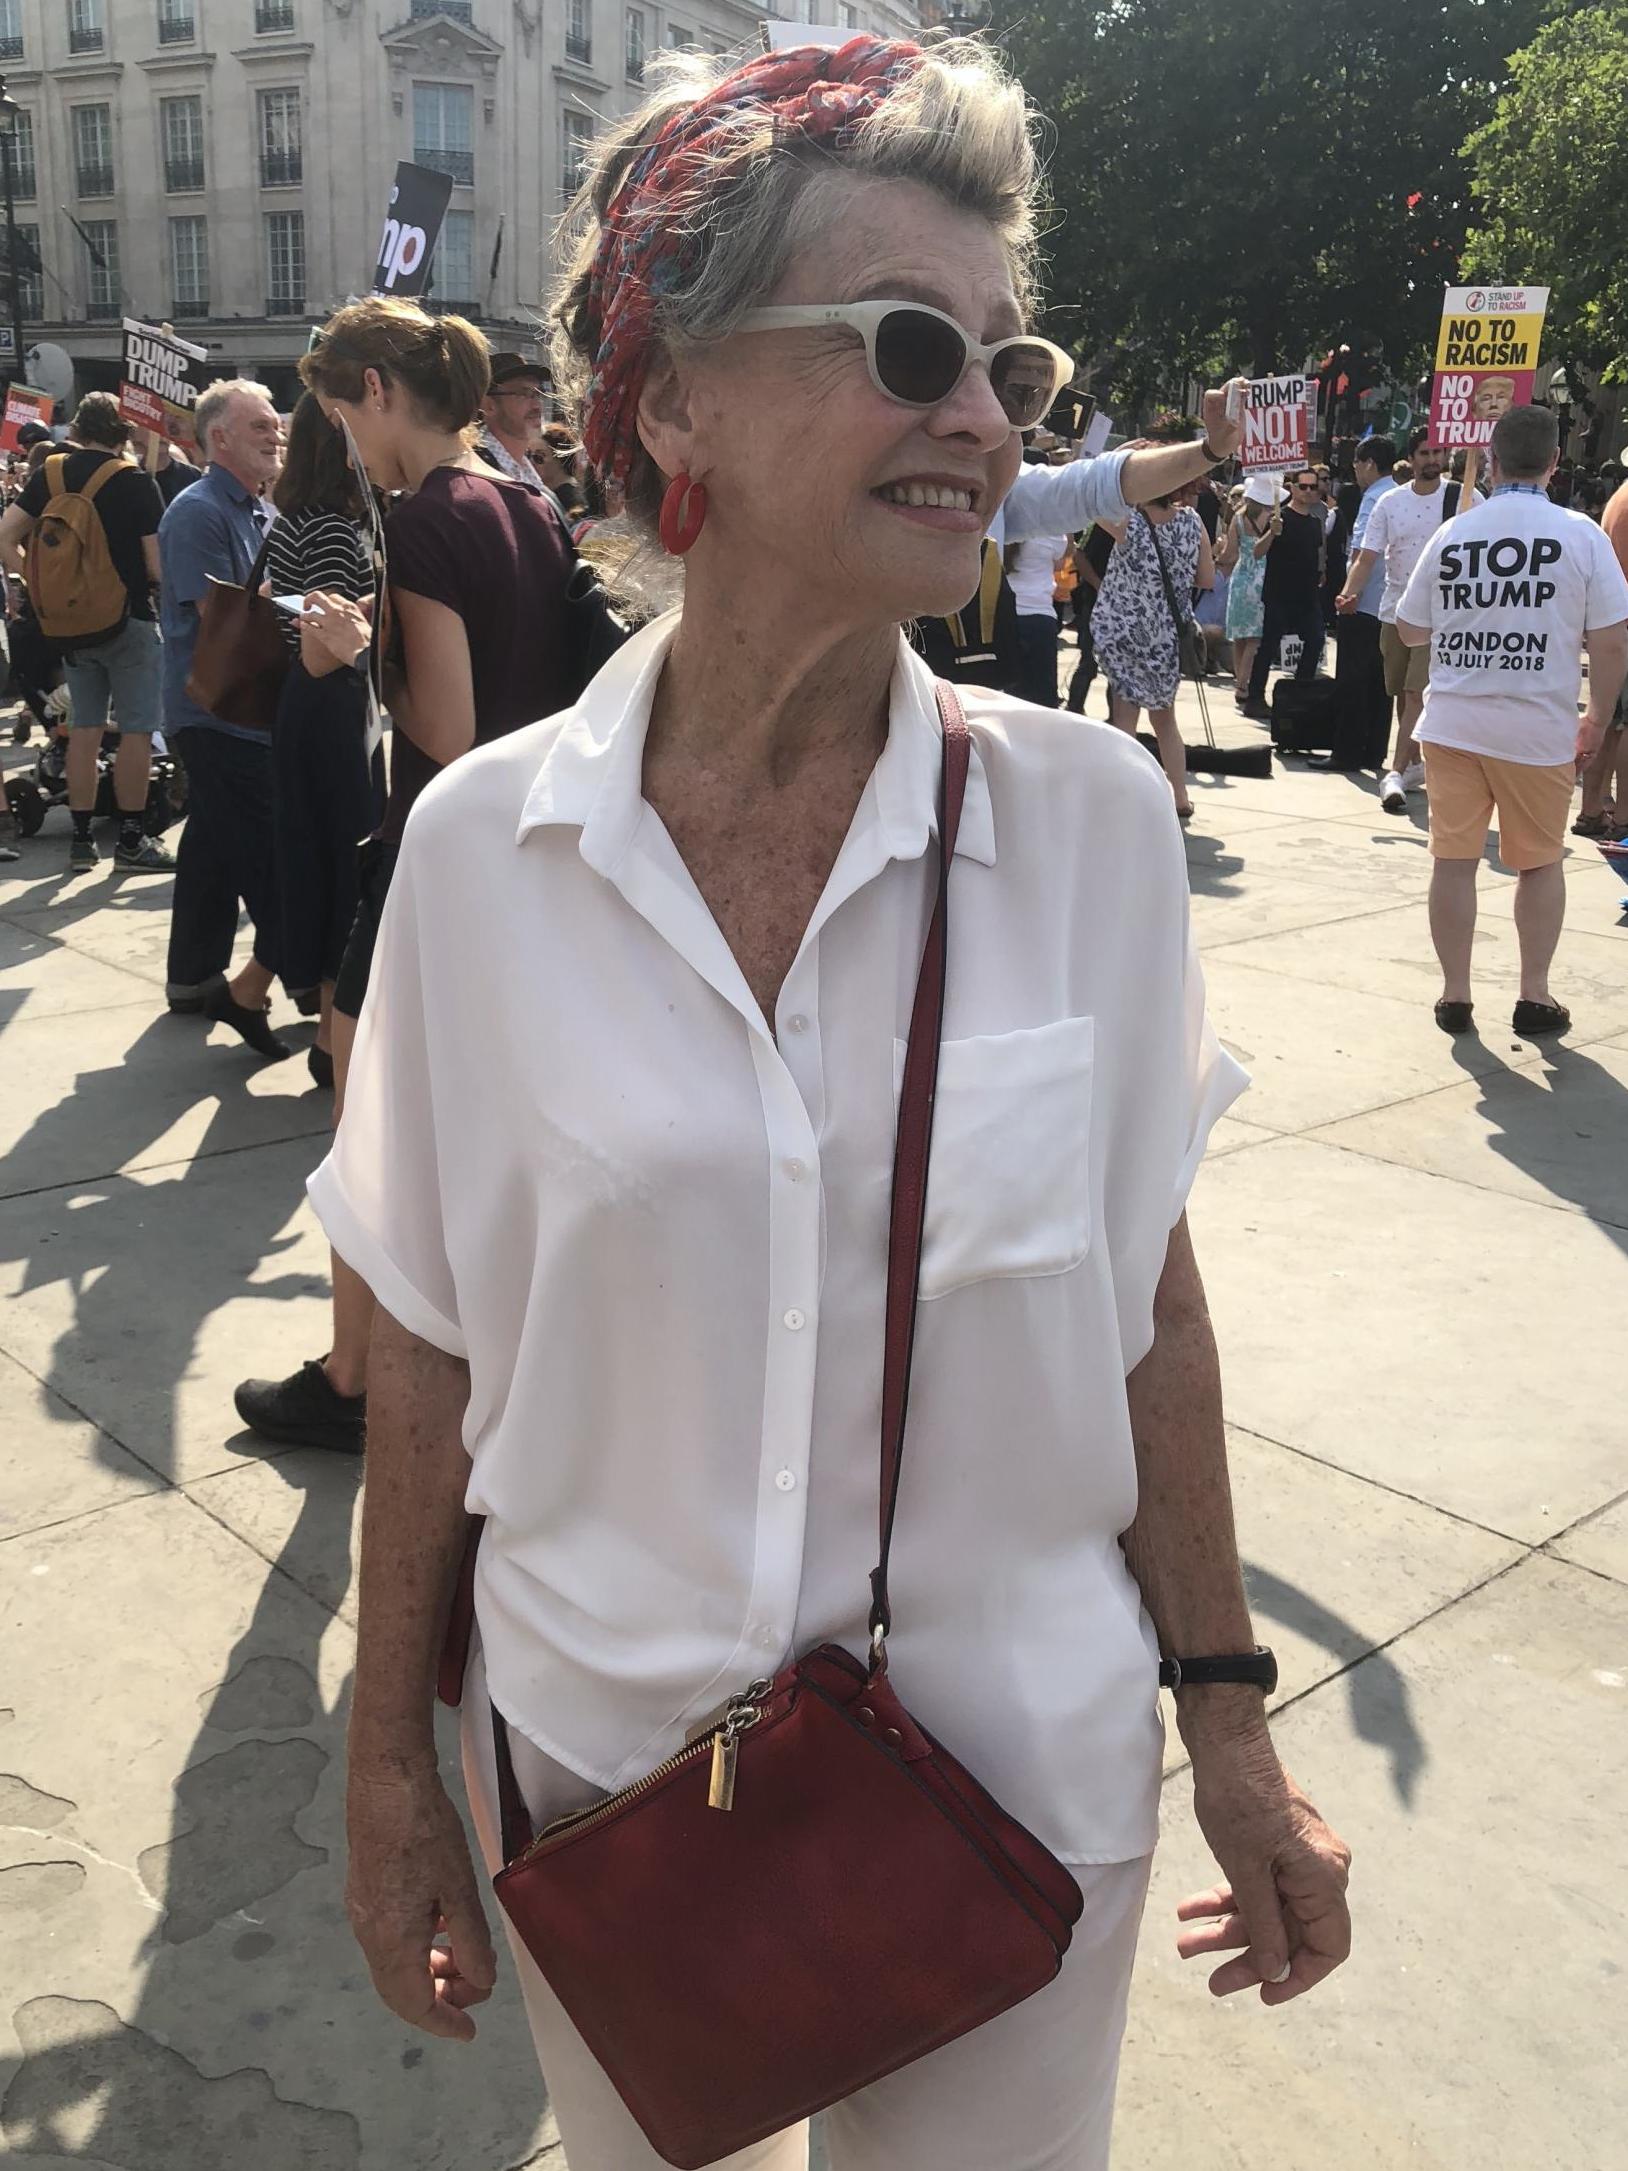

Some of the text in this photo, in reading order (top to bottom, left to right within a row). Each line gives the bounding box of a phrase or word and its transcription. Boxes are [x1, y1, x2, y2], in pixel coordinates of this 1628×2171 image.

[1488, 292, 1525, 301] STAND UP
[1488, 301, 1526, 311] TO RACISM
[1448, 319, 1516, 342] NO TO
[127, 334, 189, 378] DUMP
[1445, 342, 1528, 366] RACISM
[125, 356, 198, 406] TRUMP
[1440, 375, 1474, 398] NO
[1246, 380, 1304, 409] RUMP
[1438, 398, 1469, 421] TO
[1244, 403, 1303, 446] NOT
[1435, 420, 1498, 444] TRUM
[1245, 441, 1305, 463] WELCOME
[1439, 537, 1562, 581] STOP
[1439, 581, 1556, 610] TRUMP
[1455, 653, 1494, 669] JULY
[1499, 654, 1545, 671] 2018
